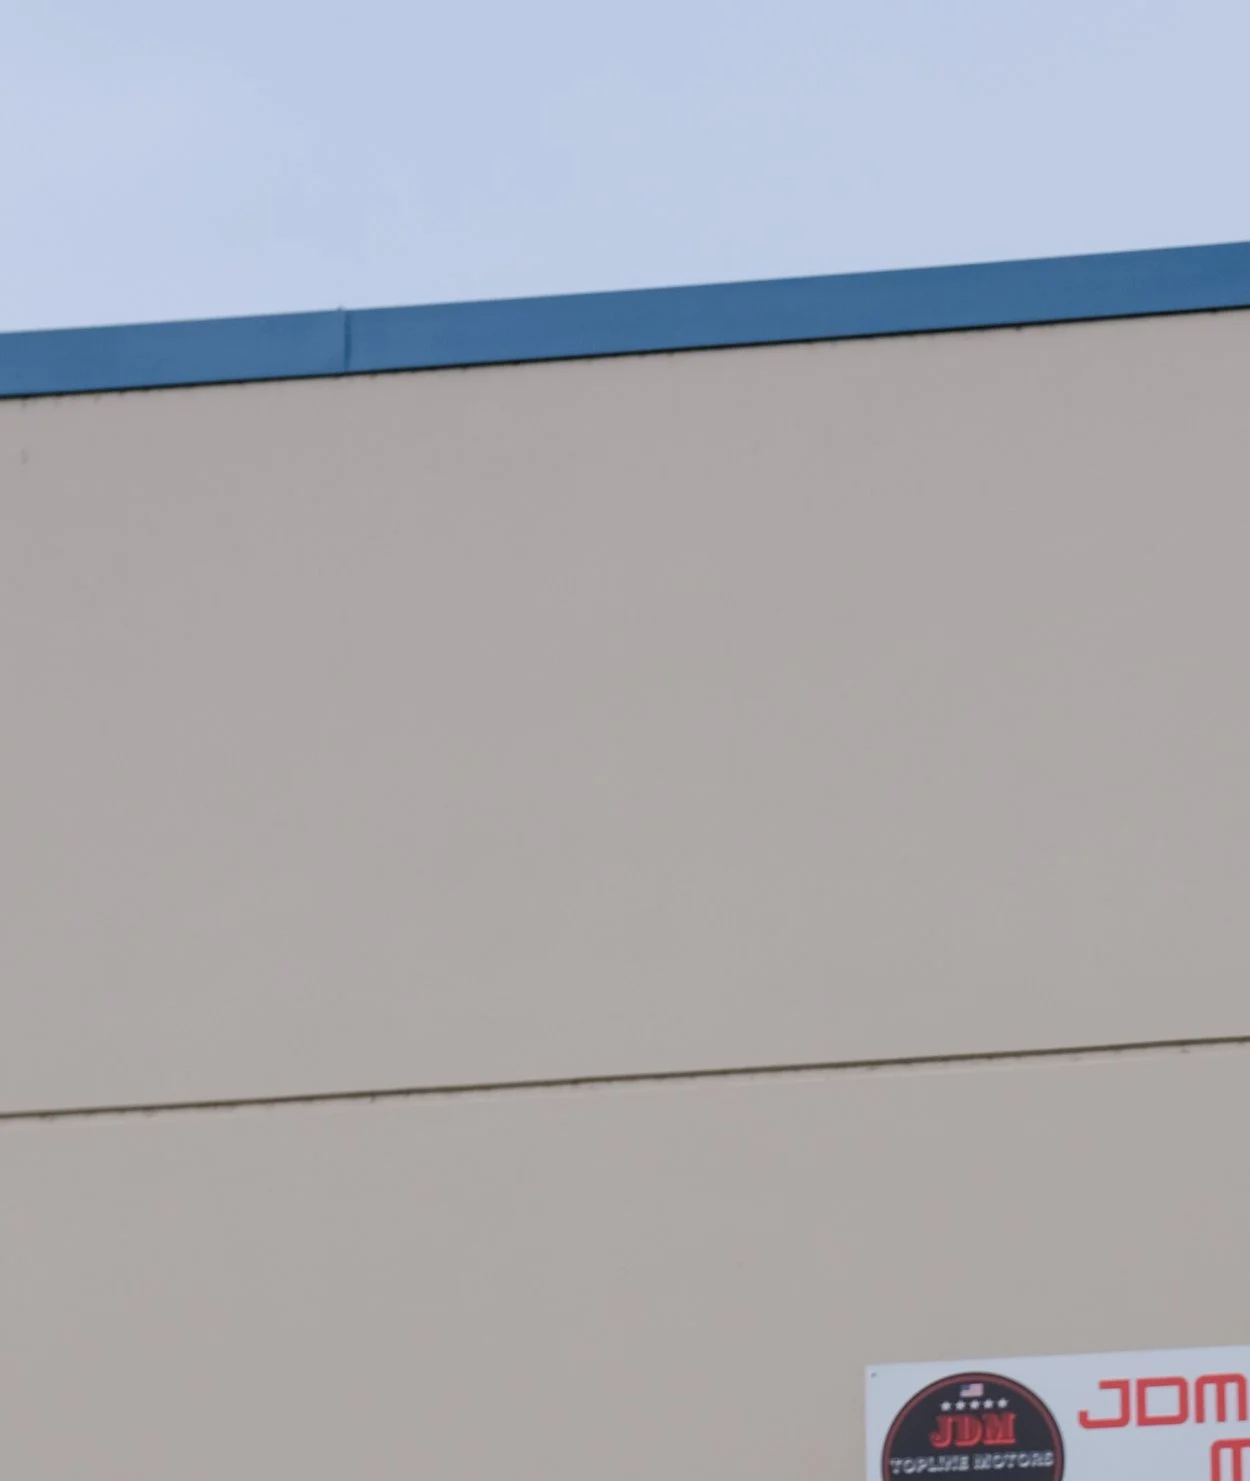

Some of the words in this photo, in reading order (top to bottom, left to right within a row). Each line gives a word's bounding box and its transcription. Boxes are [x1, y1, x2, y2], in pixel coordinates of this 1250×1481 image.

[1078, 1373, 1248, 1429] JDM
[929, 1412, 1016, 1447] JDM
[890, 1454, 970, 1475] TOPLINE
[973, 1450, 1054, 1471] MOTORS
